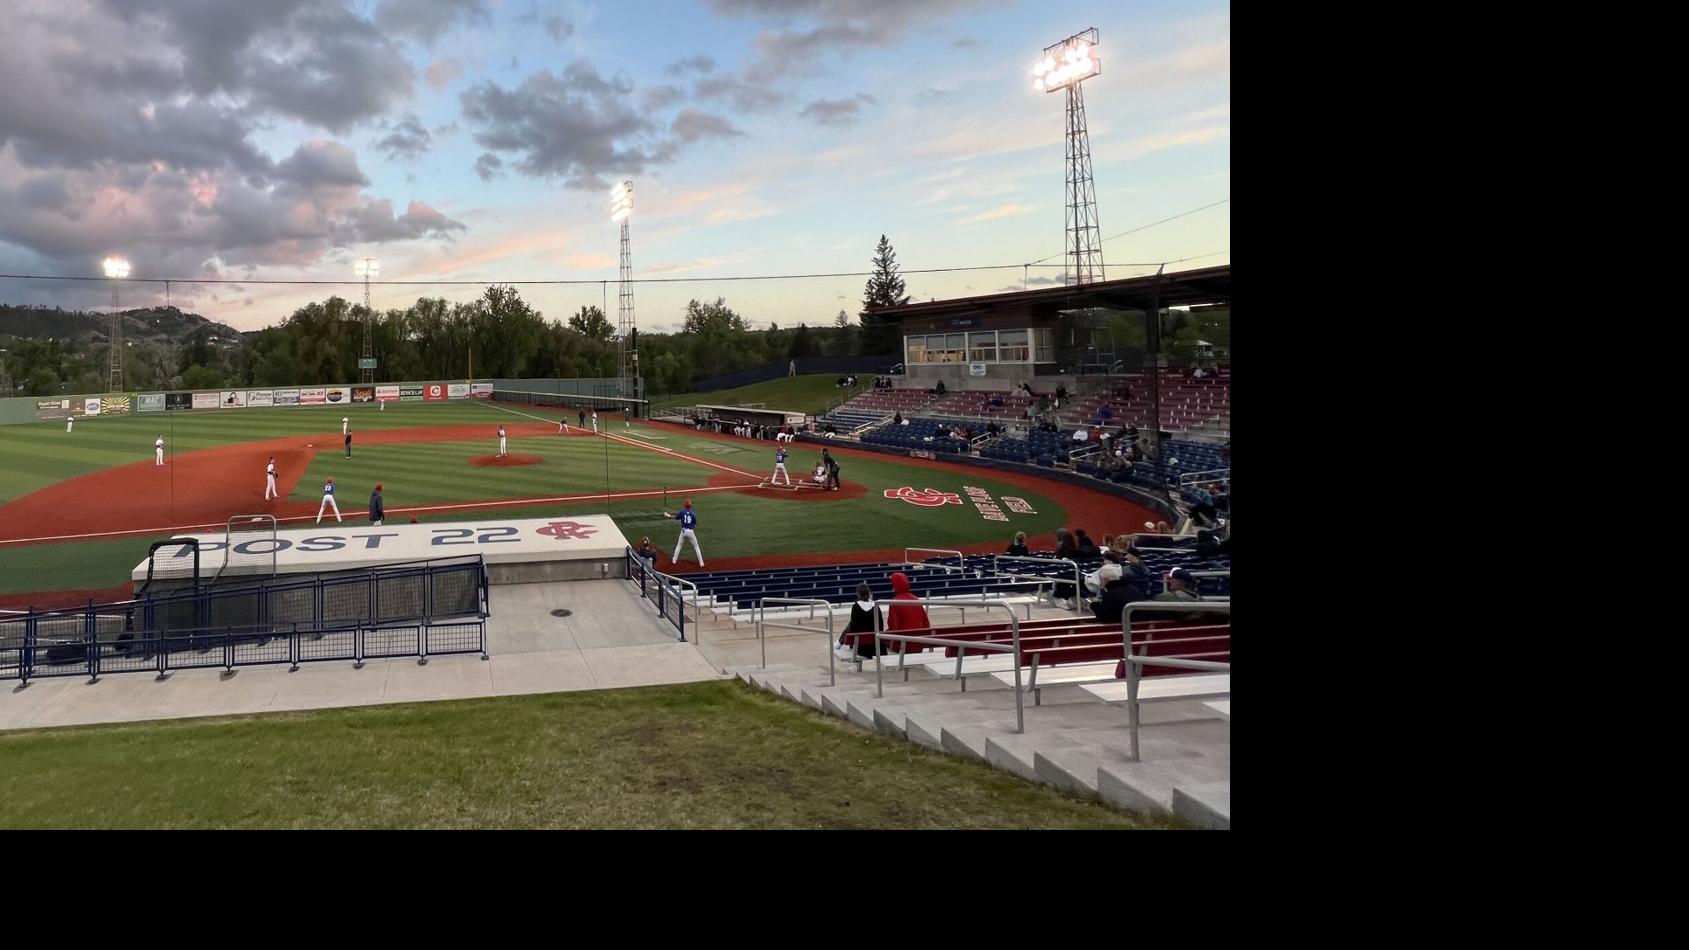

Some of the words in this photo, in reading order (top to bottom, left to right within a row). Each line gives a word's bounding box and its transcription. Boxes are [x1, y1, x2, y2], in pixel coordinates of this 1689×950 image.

[684, 515, 692, 524] 19
[172, 533, 400, 558] POST
[431, 526, 521, 546] 22
